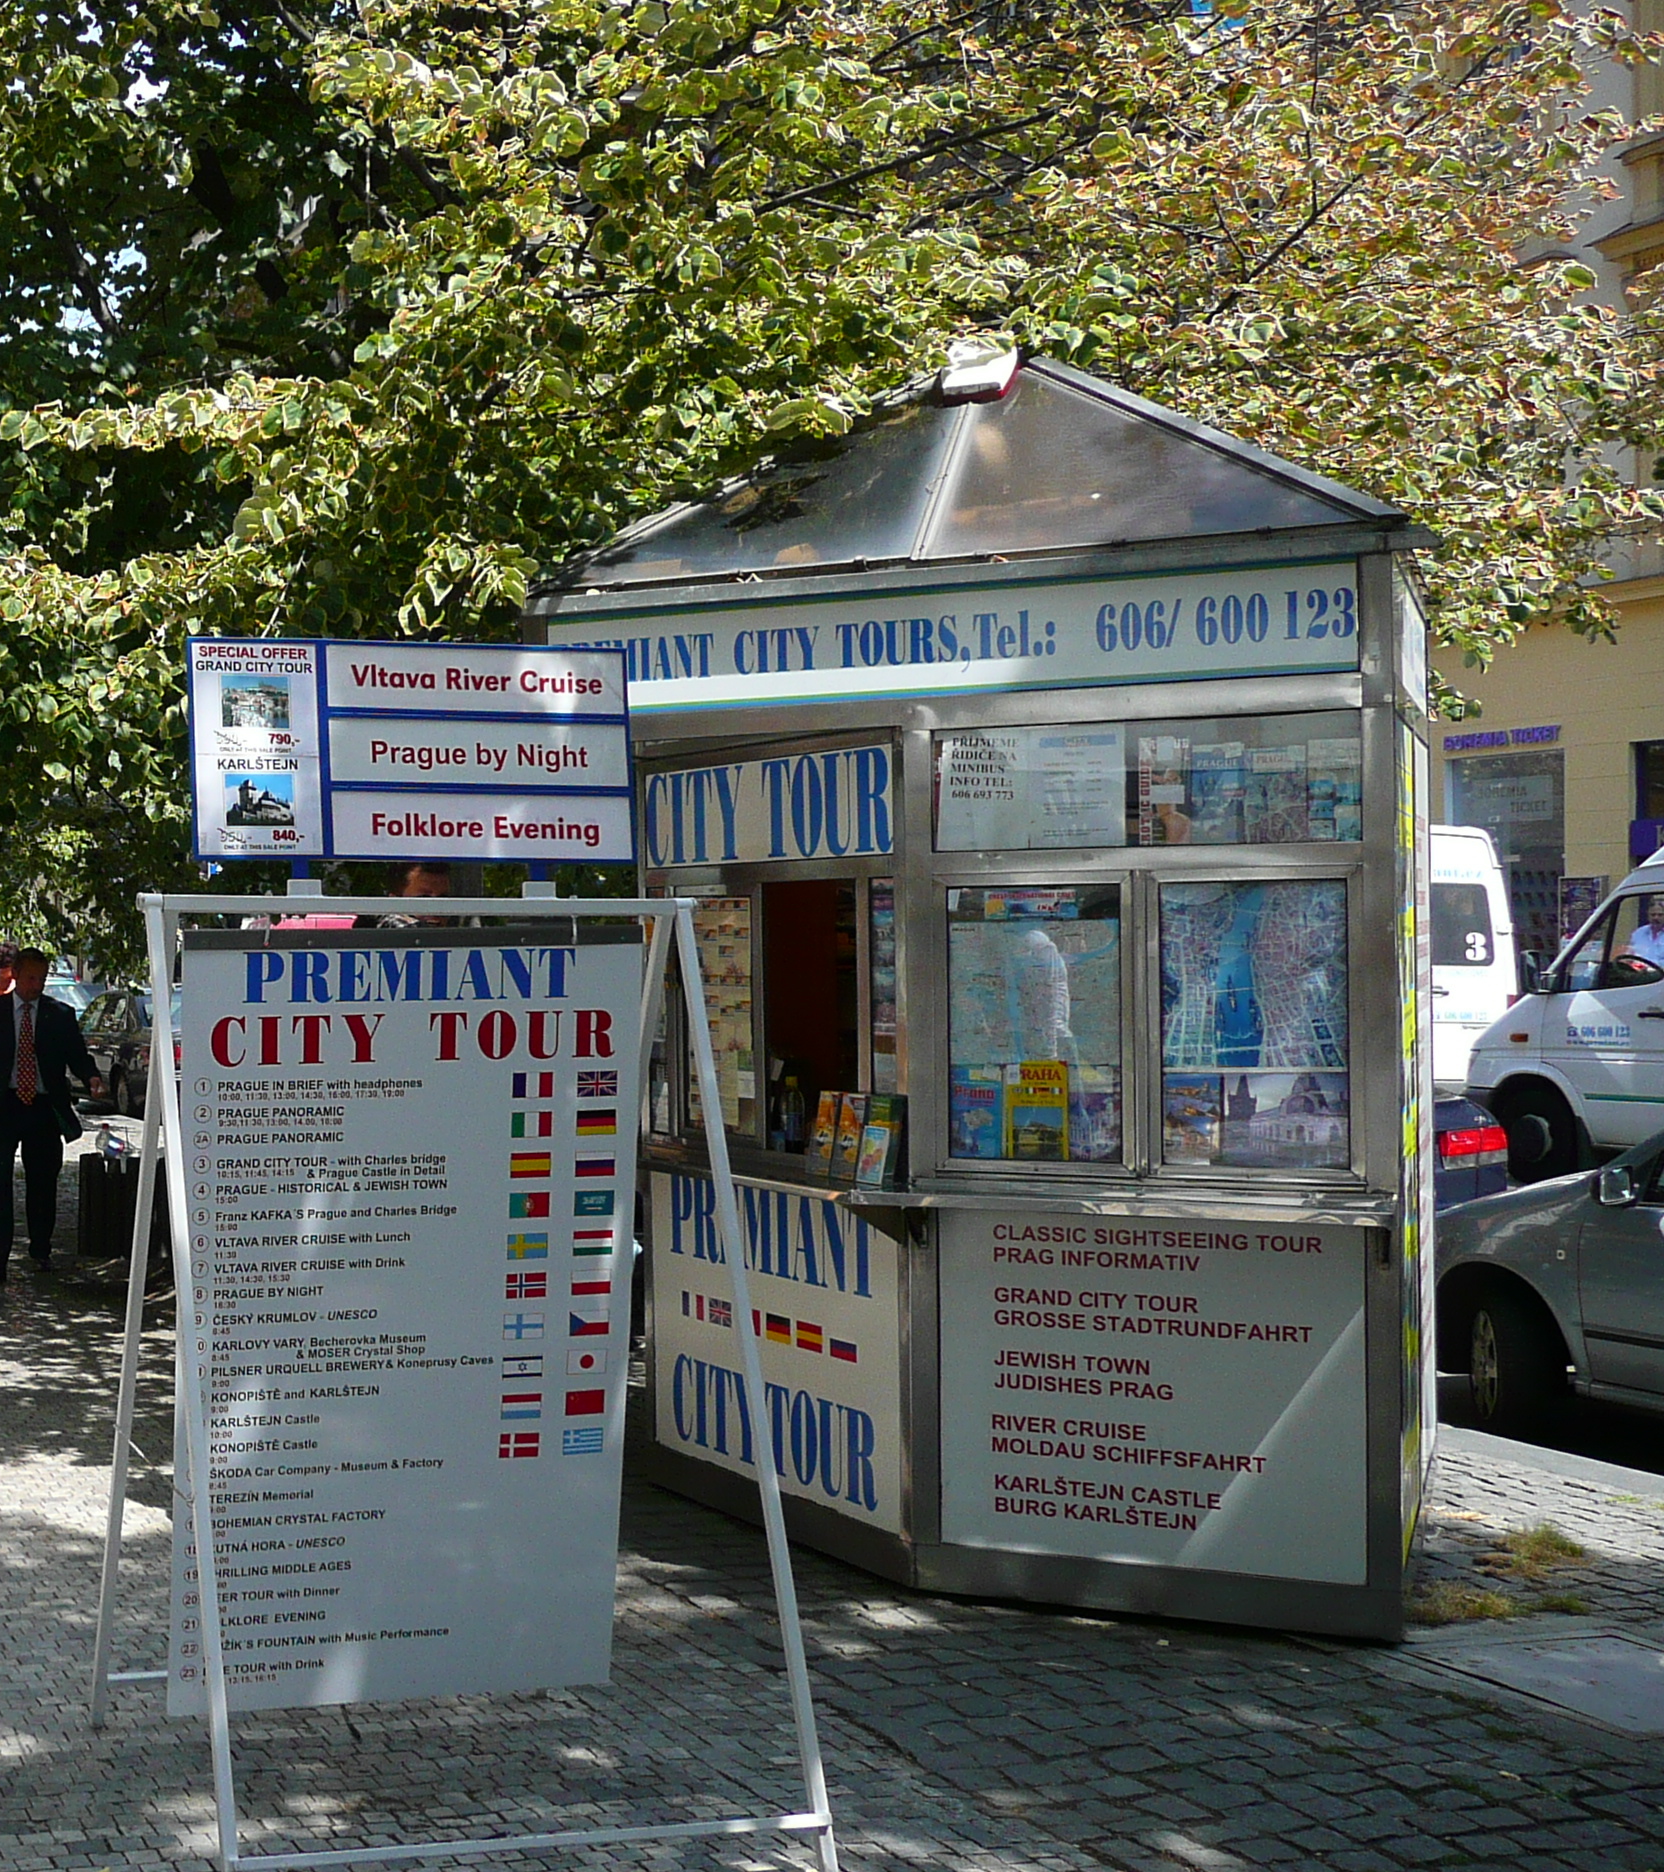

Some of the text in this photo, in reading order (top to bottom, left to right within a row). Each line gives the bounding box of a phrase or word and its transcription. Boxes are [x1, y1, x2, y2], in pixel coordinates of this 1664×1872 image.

[734, 625, 820, 676] CITY
[1095, 598, 1182, 652] 606/
[1195, 592, 1270, 646] 600
[1283, 587, 1355, 640] 123
[199, 646, 307, 659] SPECIAL OFFER
[196, 660, 313, 673] GRAND CITY TOUR
[351, 664, 603, 695] Vltava River Cruise
[1510, 725, 1562, 744] TICKET
[218, 756, 298, 770] KARLŠTEJN
[371, 740, 588, 773] Prague by Night
[951, 764, 1005, 773] MINIBUS
[950, 777, 980, 786] INFO
[646, 746, 893, 867] CITY TOUR
[952, 791, 1014, 800] 606 693 773
[371, 813, 600, 847] Folklore Evening
[1465, 932, 1486, 961] 3
[242, 948, 576, 1004] PREMIANT
[210, 1009, 616, 1068] CITY TOUR
[218, 1078, 423, 1092] PRAGUE IN BRIEF with headphones
[217, 1106, 345, 1119] PRAGUE PANORAMIC
[217, 1154, 446, 1169] GRAND CITY TOUR with Charles bridge
[216, 1184, 267, 1196] PRAGUE
[277, 1182, 349, 1195] HISTORICAL
[364, 1180, 409, 1191] JEWISH
[413, 1179, 447, 1190] TOWN
[215, 1232, 411, 1248] VLTAVA RIVER CRUISE with Lunch
[670, 1172, 876, 1299] PRMIANT
[992, 1224, 1322, 1253] CLASSIC SIGHTSEEING TOUR
[214, 1257, 405, 1274] VLTAVA RIVER CRUISE with Drink
[992, 1248, 1201, 1272] PRAG INFORMATIV
[213, 1286, 324, 1300] PRAGUE BY NIGHT
[994, 1286, 1198, 1313] GRAND CITY TOUR
[212, 1308, 378, 1326] ČESKÝ KRUMLOV UNESCO
[994, 1310, 1313, 1343] GROSSE STADTRUNDFAHRT
[212, 1339, 270, 1352] KARLOVY
[310, 1335, 376, 1348] Becherovka
[379, 1333, 426, 1345] Museum
[994, 1350, 1151, 1376] JEWISH TOWN
[211, 1384, 380, 1404] KONOPIŠTĚ and KARLŠTEJN
[994, 1373, 1174, 1401] JUDISHES PRAG
[210, 1414, 320, 1428] KARLŠTEJN Castle
[991, 1414, 1147, 1441] RIVER CRUISE
[765, 1382, 878, 1512] TOUR
[991, 1437, 1267, 1474] MOLDAU SCHIFFSFAHRT
[209, 1465, 252, 1479] ŠKODA
[255, 1465, 274, 1477] Car
[277, 1464, 331, 1477] Company
[341, 1460, 388, 1472] Museum
[402, 1457, 444, 1469] Factory
[994, 1473, 1222, 1511] KARLŠTEJN CASTLE
[275, 1513, 329, 1526] CRYSTAL
[332, 1509, 386, 1522] FACTORY
[994, 1497, 1198, 1531] BURG KARLŠTEJN
[215, 1560, 351, 1579] HRILLING MIDDLE AGES
